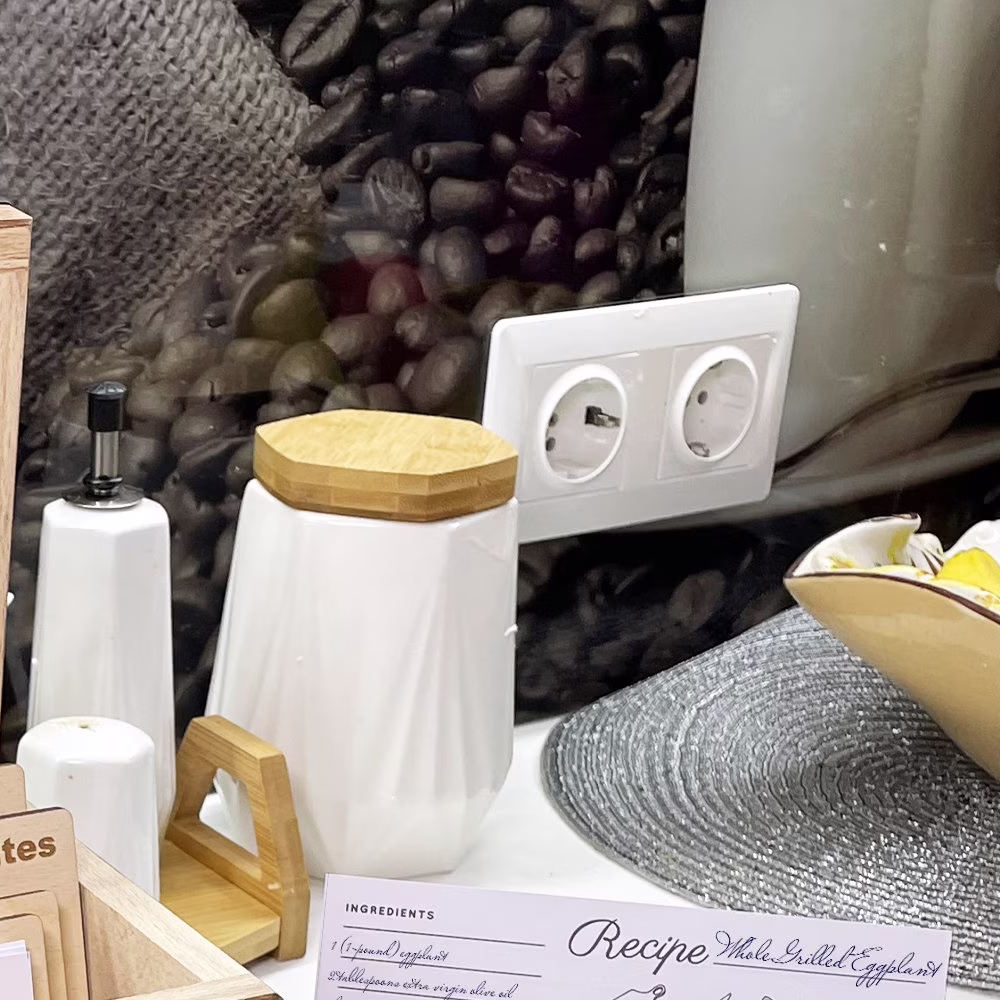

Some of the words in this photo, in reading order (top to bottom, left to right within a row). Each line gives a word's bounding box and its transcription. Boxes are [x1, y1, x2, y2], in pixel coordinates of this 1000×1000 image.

[345, 903, 435, 920] INGREDIENTS
[340, 935, 401, 962] (1-pound)
[399, 944, 449, 969] eggplant
[568, 918, 709, 976] Recipe
[715, 930, 772, 962] Whole
[770, 938, 855, 969] Grilled
[851, 946, 943, 988] Eggplant
[335, 966, 400, 993] tablespoons
[403, 978, 430, 990] extra
[469, 980, 496, 998] olive
[498, 983, 519, 999] oil
